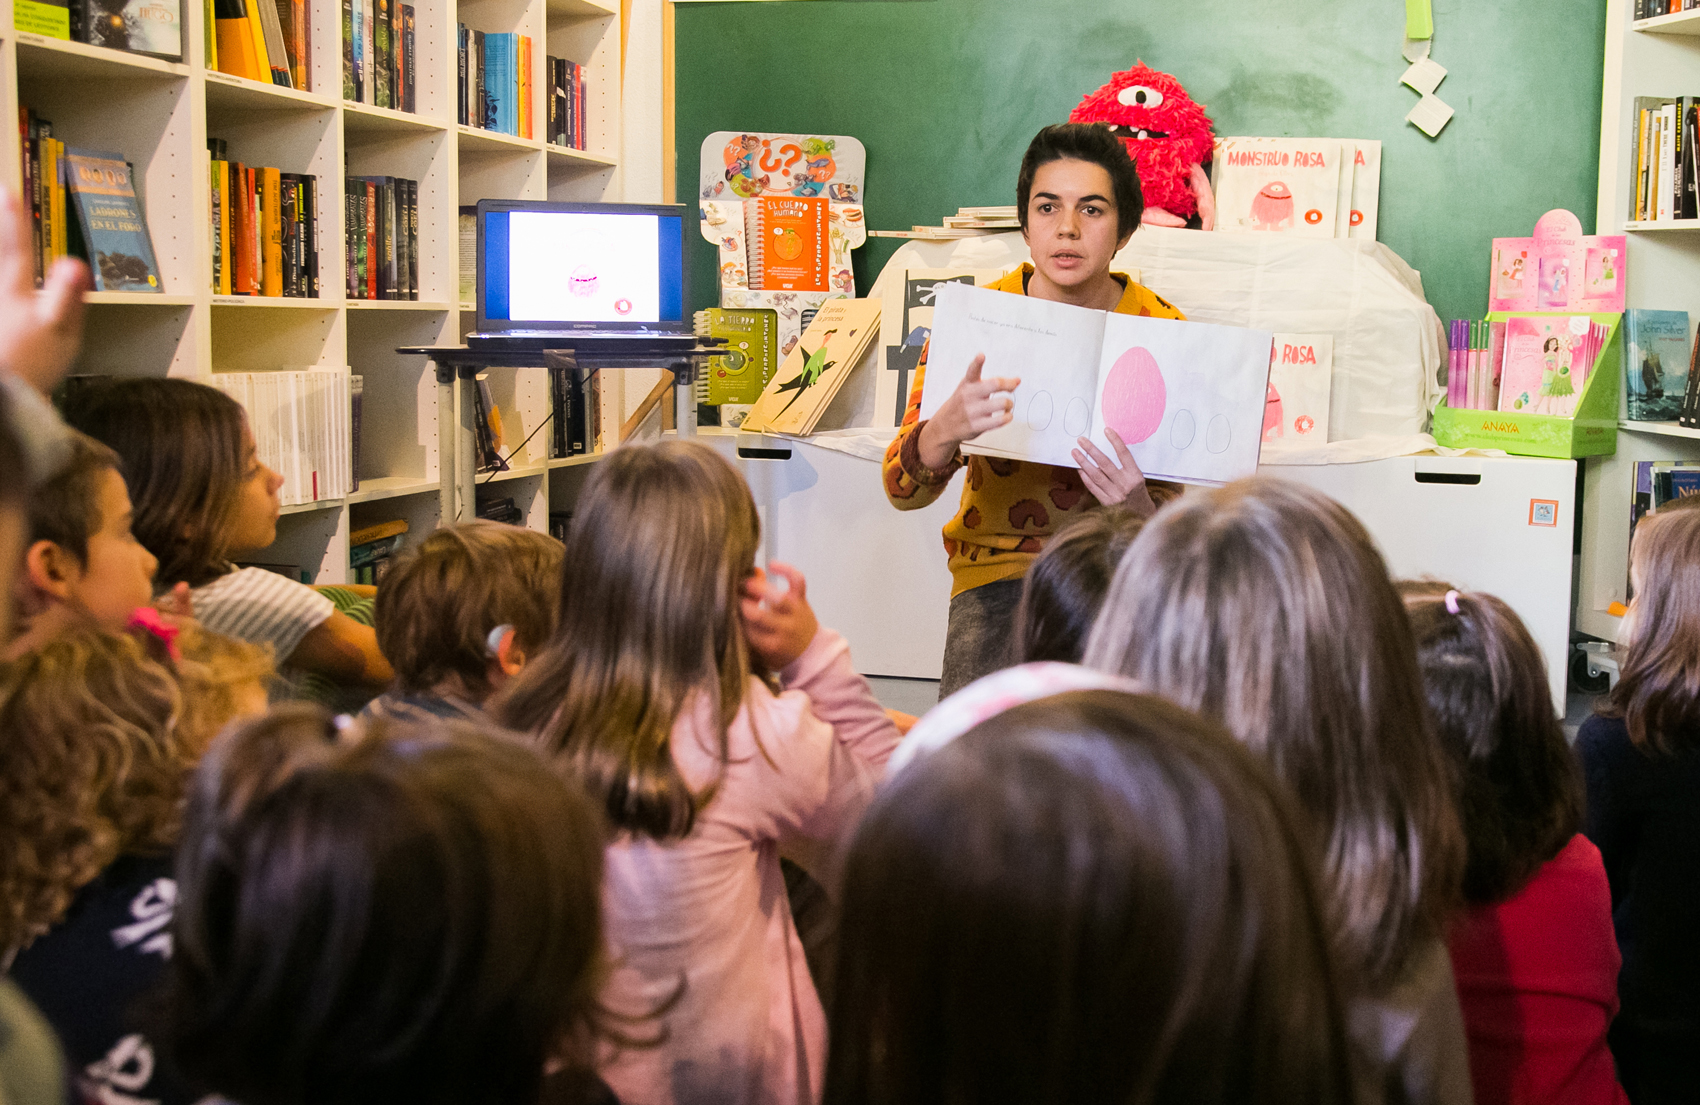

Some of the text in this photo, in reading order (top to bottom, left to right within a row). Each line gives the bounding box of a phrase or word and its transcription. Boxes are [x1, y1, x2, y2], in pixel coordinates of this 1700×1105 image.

[1228, 150, 1326, 168] MONSTRUO ROSA
[768, 200, 808, 211] EL CUERPO
[90, 207, 136, 218] LADRONES
[91, 220, 142, 232] EN EL FORO
[715, 316, 755, 325] LA TIERRA
[1640, 324, 1686, 334] John Silver
[1282, 344, 1316, 366] ROSA
[1482, 421, 1519, 433] ANAYA
